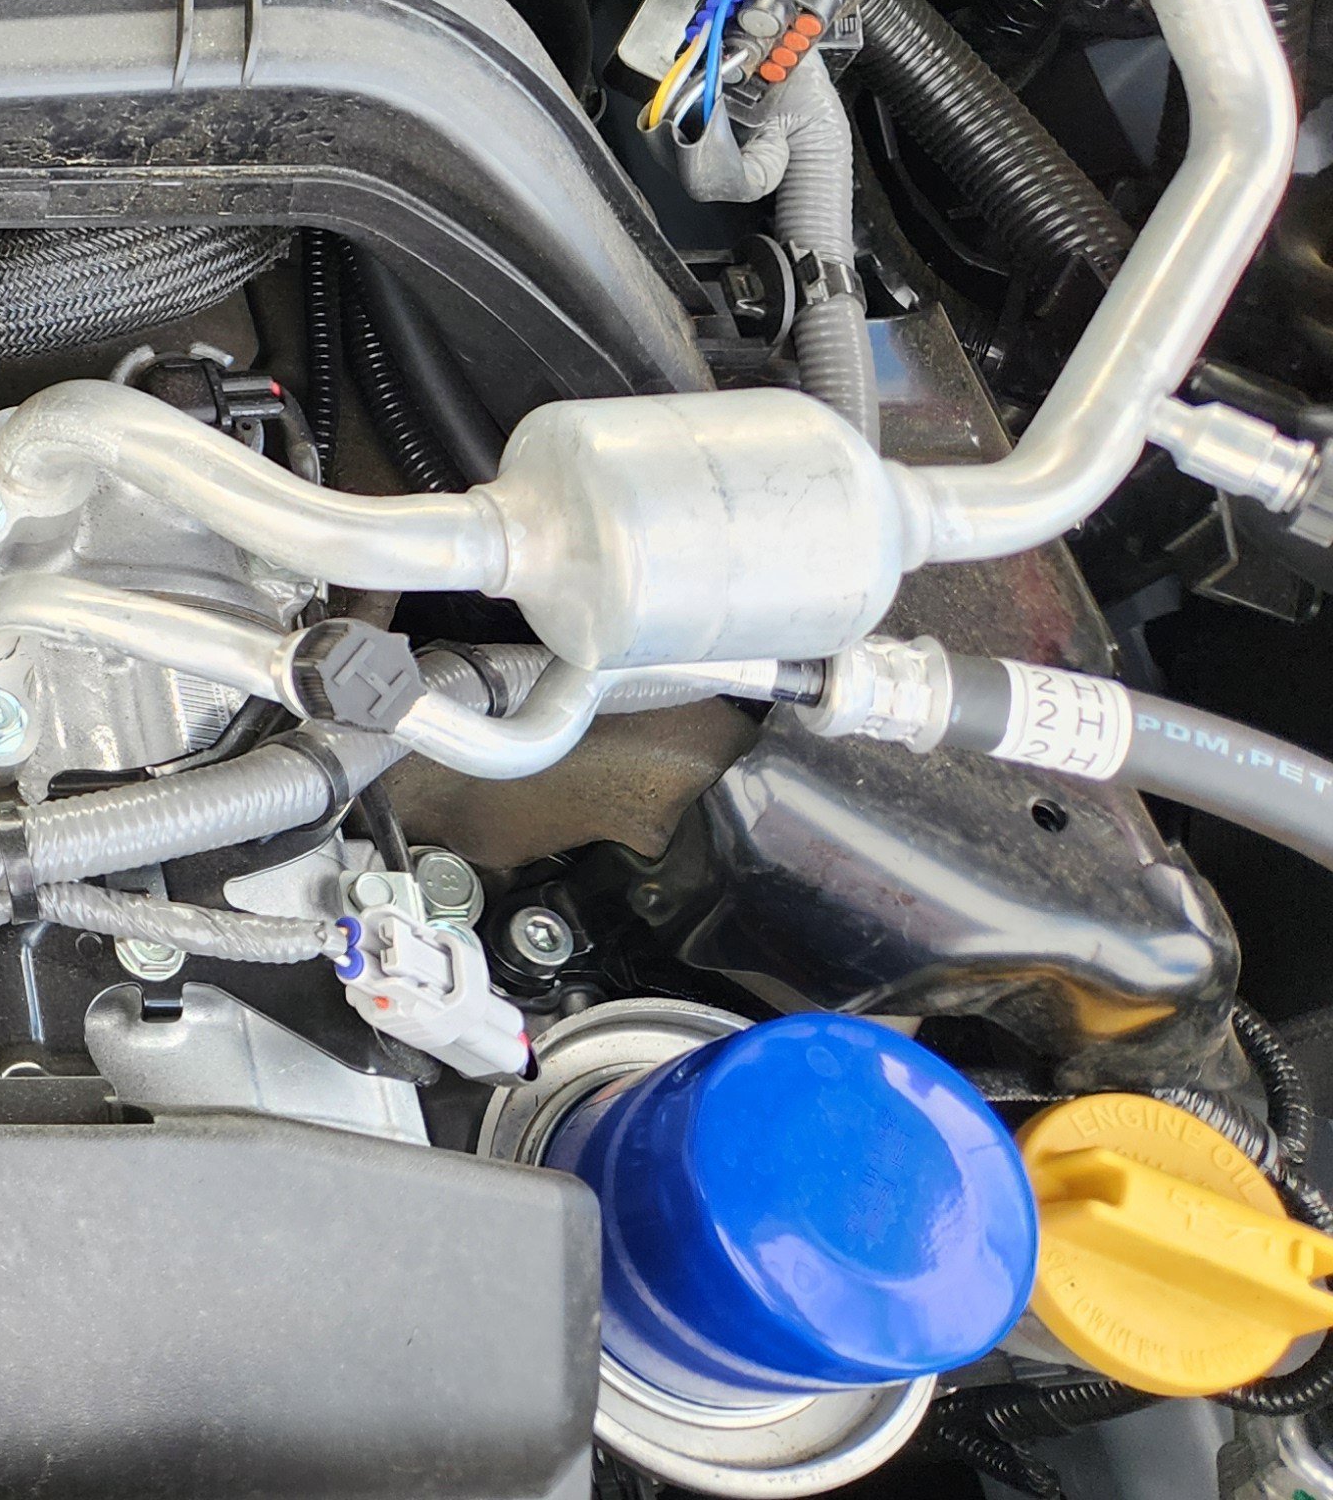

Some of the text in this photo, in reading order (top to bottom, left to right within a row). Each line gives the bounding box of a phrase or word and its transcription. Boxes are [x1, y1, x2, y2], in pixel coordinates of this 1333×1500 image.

[331, 638, 413, 720] H
[1070, 1104, 1205, 1149] ENGINE
[1212, 1143, 1266, 1202] OIL
